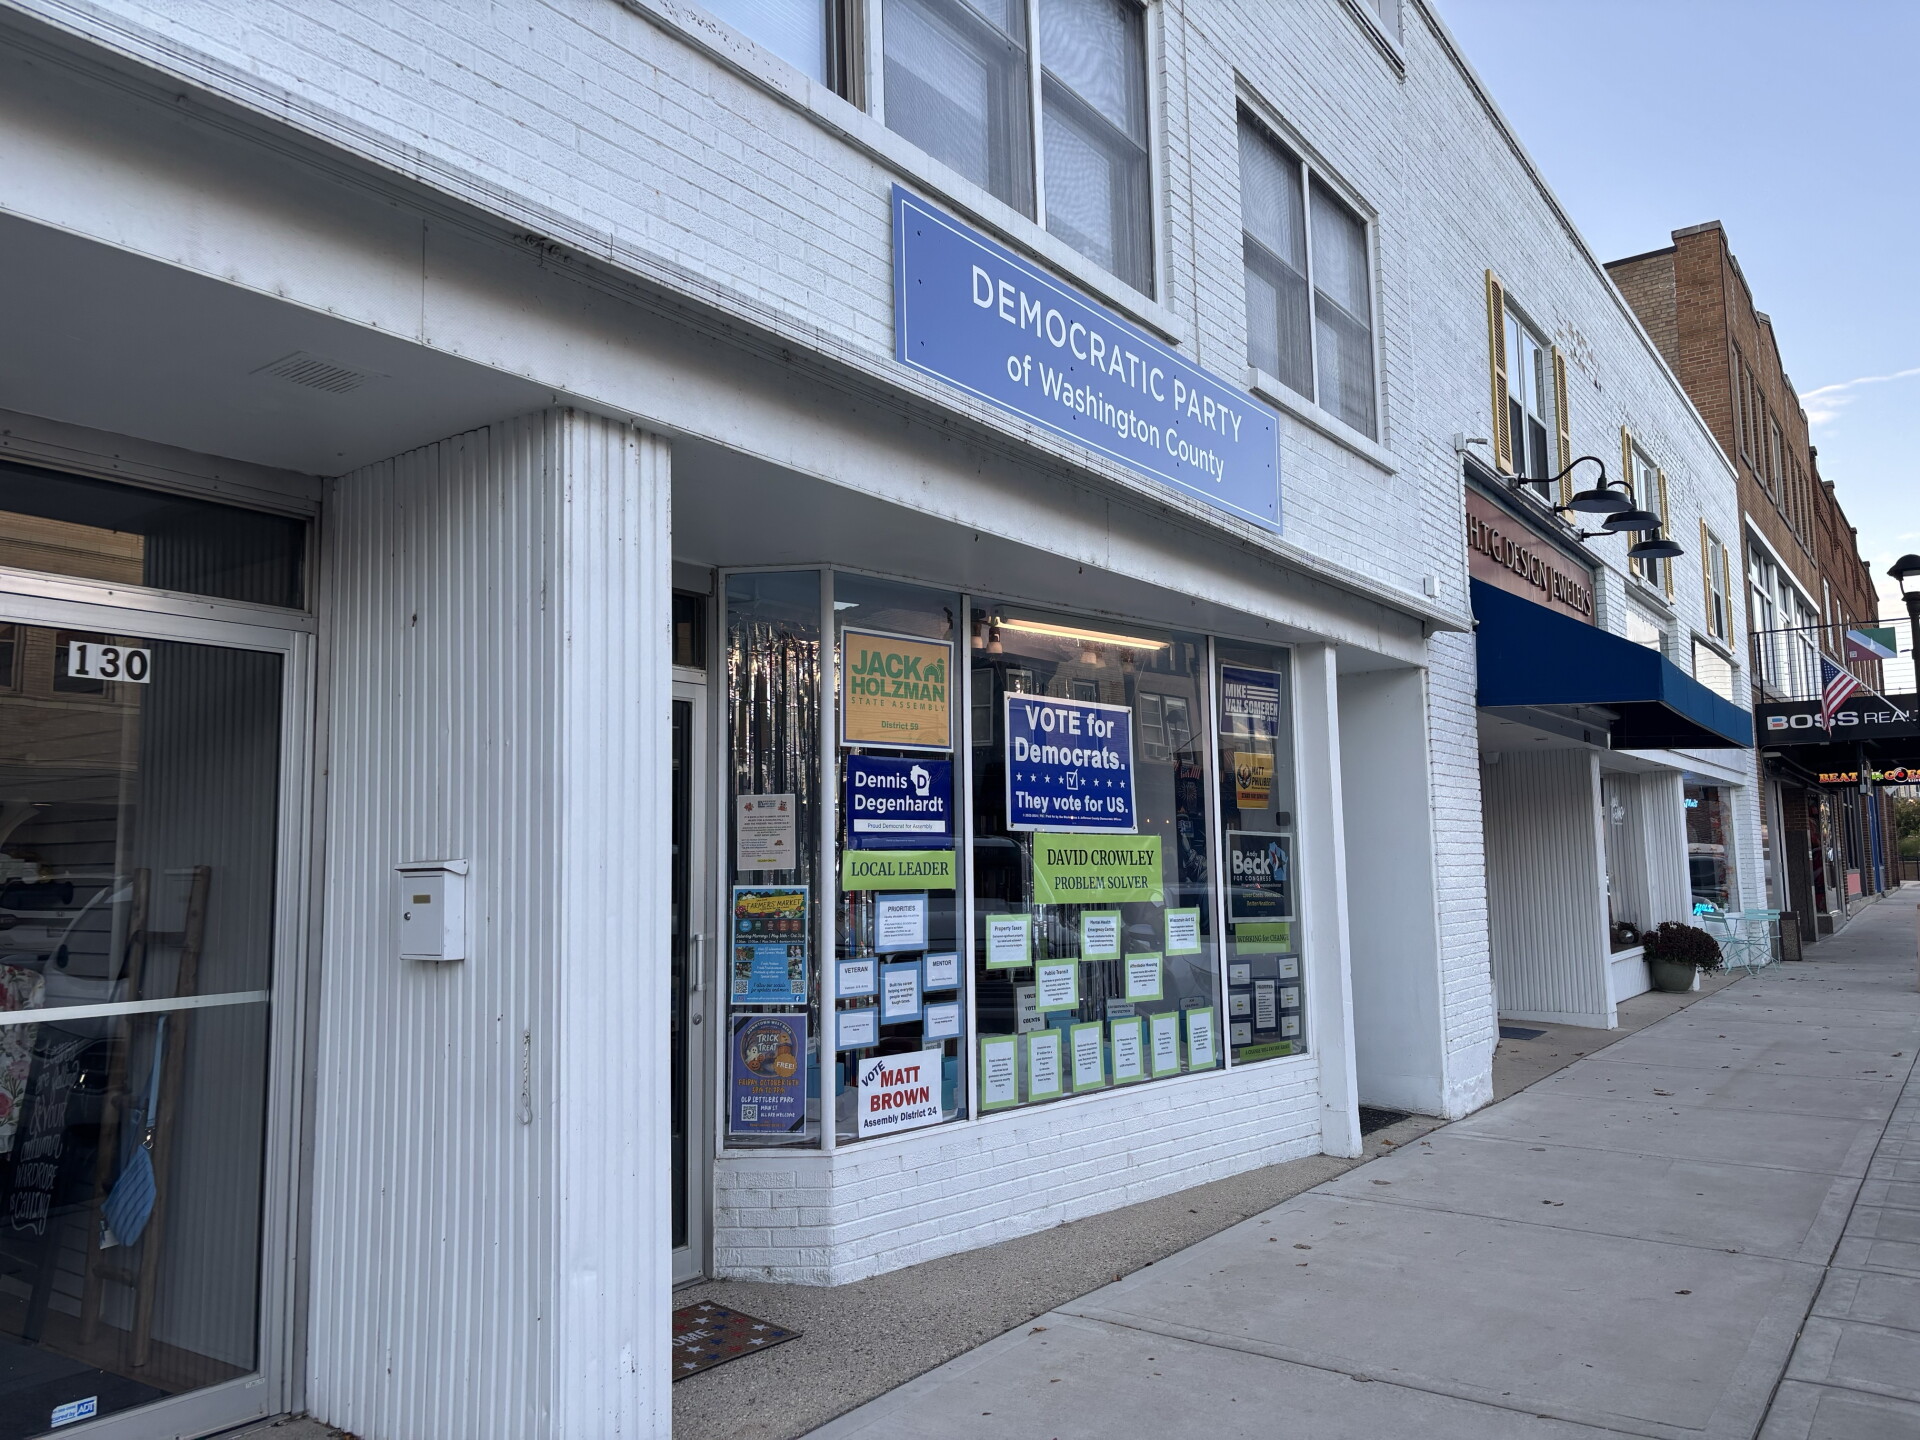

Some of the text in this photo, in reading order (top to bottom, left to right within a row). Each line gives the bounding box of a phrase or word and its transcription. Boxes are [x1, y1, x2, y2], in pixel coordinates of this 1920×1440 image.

[972, 264, 1243, 443] DEMOCRATIC PARTY
[1007, 355, 1225, 483] of Washington County
[1503, 537, 1547, 592] DESIGN
[1546, 566, 1592, 616] JEWELERS
[75, 644, 148, 681] 130
[851, 650, 922, 681] JACK
[851, 676, 945, 703] HOLZMAN
[1225, 683, 1246, 698] MIKE
[851, 697, 945, 712] STATE ASSEMBLY
[1225, 698, 1278, 716] VAN SOMEREN
[881, 720, 919, 731] District 59
[1025, 705, 1114, 738] VOTE for
[1767, 711, 1859, 731] BOSS
[1015, 737, 1126, 770] Democrats.
[855, 771, 908, 789] Dennis
[1252, 766, 1264, 776] MATT
[1819, 772, 1858, 783] BEAT
[854, 794, 944, 813] Degenhardt
[1016, 791, 1128, 813] They vote for US.
[1047, 849, 1154, 866] DAVID CROWLEY
[1232, 850, 1271, 874] Beck
[1246, 851, 1257, 859] Andy
[852, 862, 949, 876] LOCAL LEADER
[1055, 876, 1148, 890] PROBLEM SOLVER
[777, 899, 801, 907] MARKET
[1237, 935, 1262, 943] WORKING
[845, 966, 868, 974] VETERAN
[757, 1034, 779, 1043] TRICK
[758, 1043, 778, 1051] TREAT
[861, 1060, 886, 1087] VOTE
[880, 1066, 920, 1087] MATT
[870, 1086, 930, 1112] BROWN
[863, 1106, 937, 1128] Assembly District 24
[15, 1162, 58, 1190] WARDROBE
[78, 1402, 95, 1414] ADT
